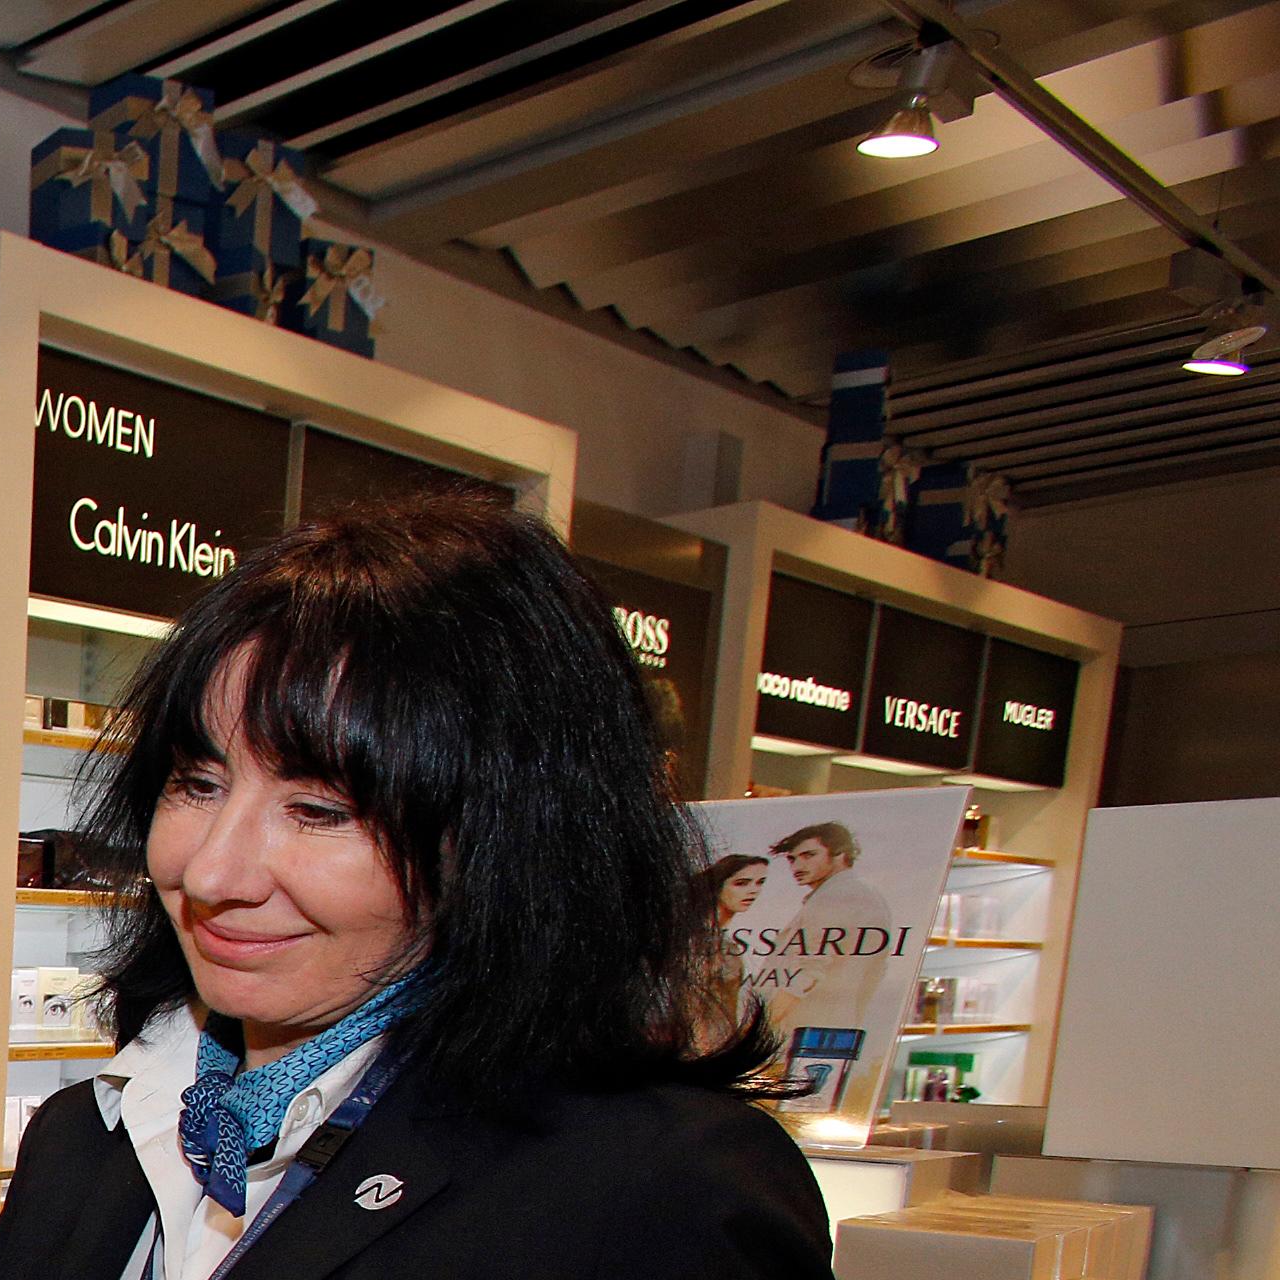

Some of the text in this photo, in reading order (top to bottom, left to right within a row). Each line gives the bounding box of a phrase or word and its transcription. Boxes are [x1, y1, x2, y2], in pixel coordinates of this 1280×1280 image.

[35, 389, 154, 458] WOMEN
[70, 498, 236, 577] Calvin Klein
[790, 677, 850, 711] rabanne
[885, 696, 961, 738] VERSACE
[1004, 701, 1055, 731] MUGLER
[727, 926, 912, 957] SSARDI
[740, 968, 803, 988] WAY
